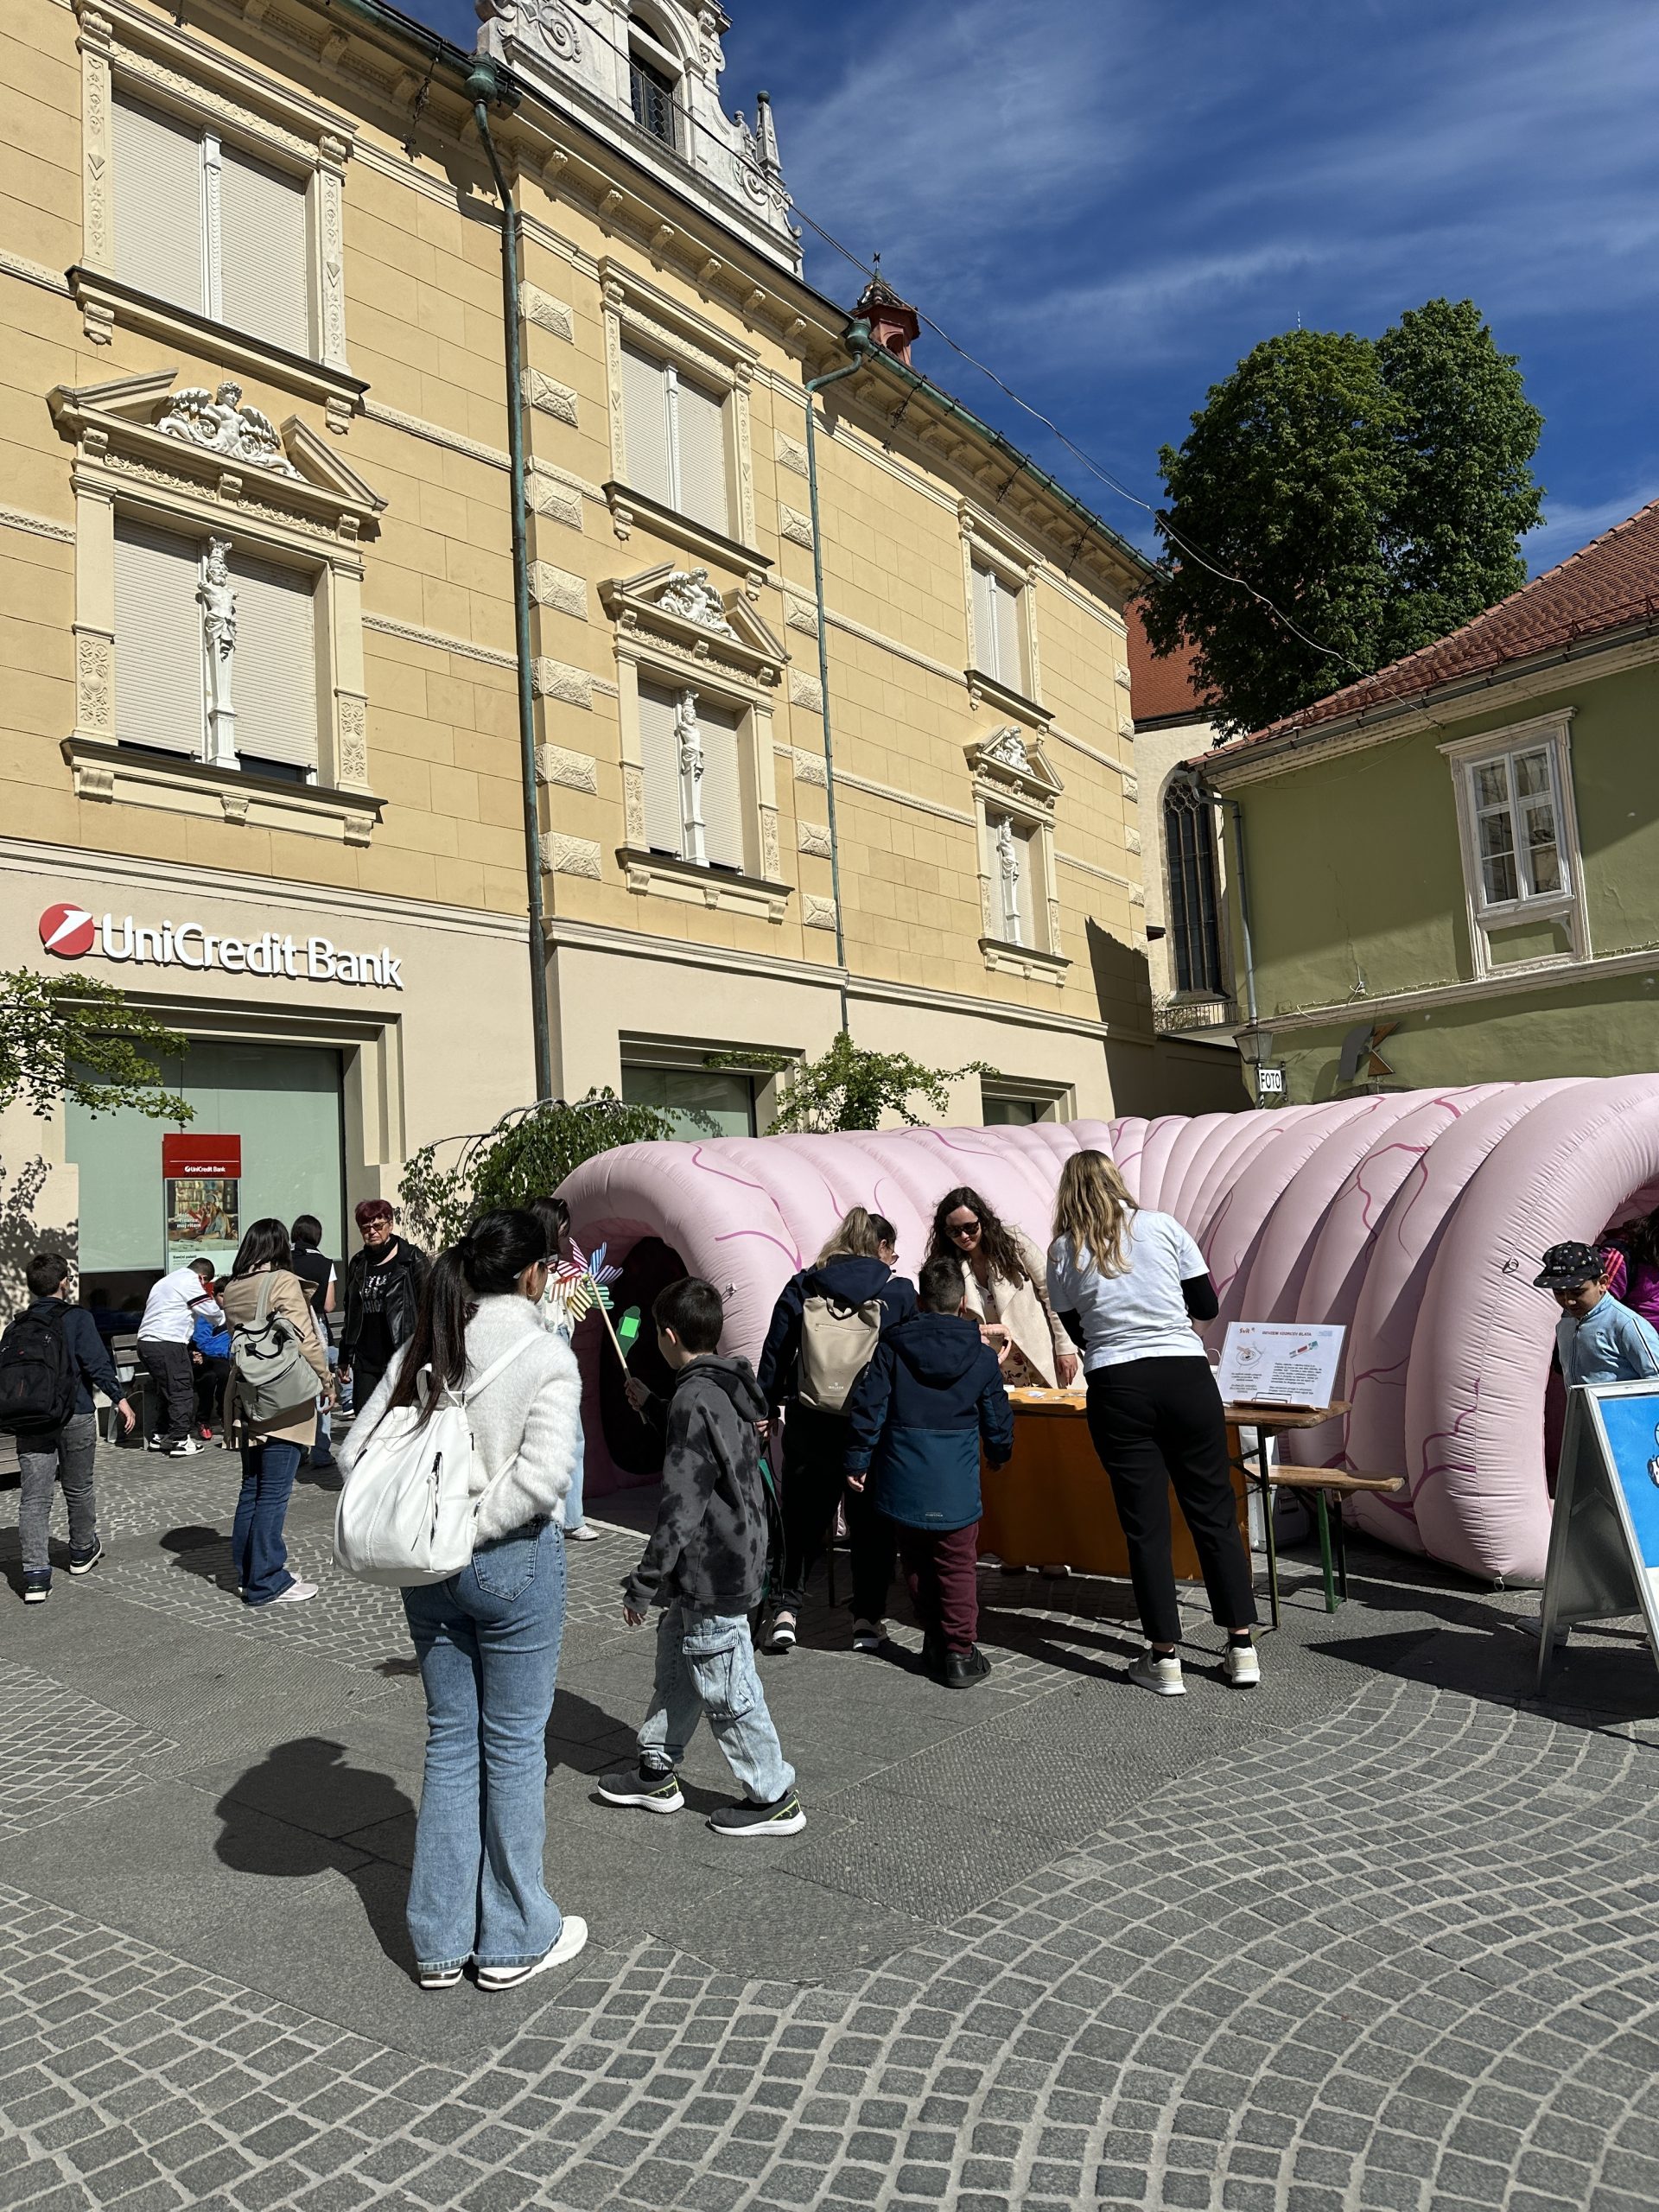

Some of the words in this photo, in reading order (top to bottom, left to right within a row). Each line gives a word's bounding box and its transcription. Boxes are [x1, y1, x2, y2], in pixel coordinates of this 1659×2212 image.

[101, 912, 298, 977] UniCredit
[307, 937, 404, 988] Bank
[1260, 1072, 1281, 1089] FOTO
